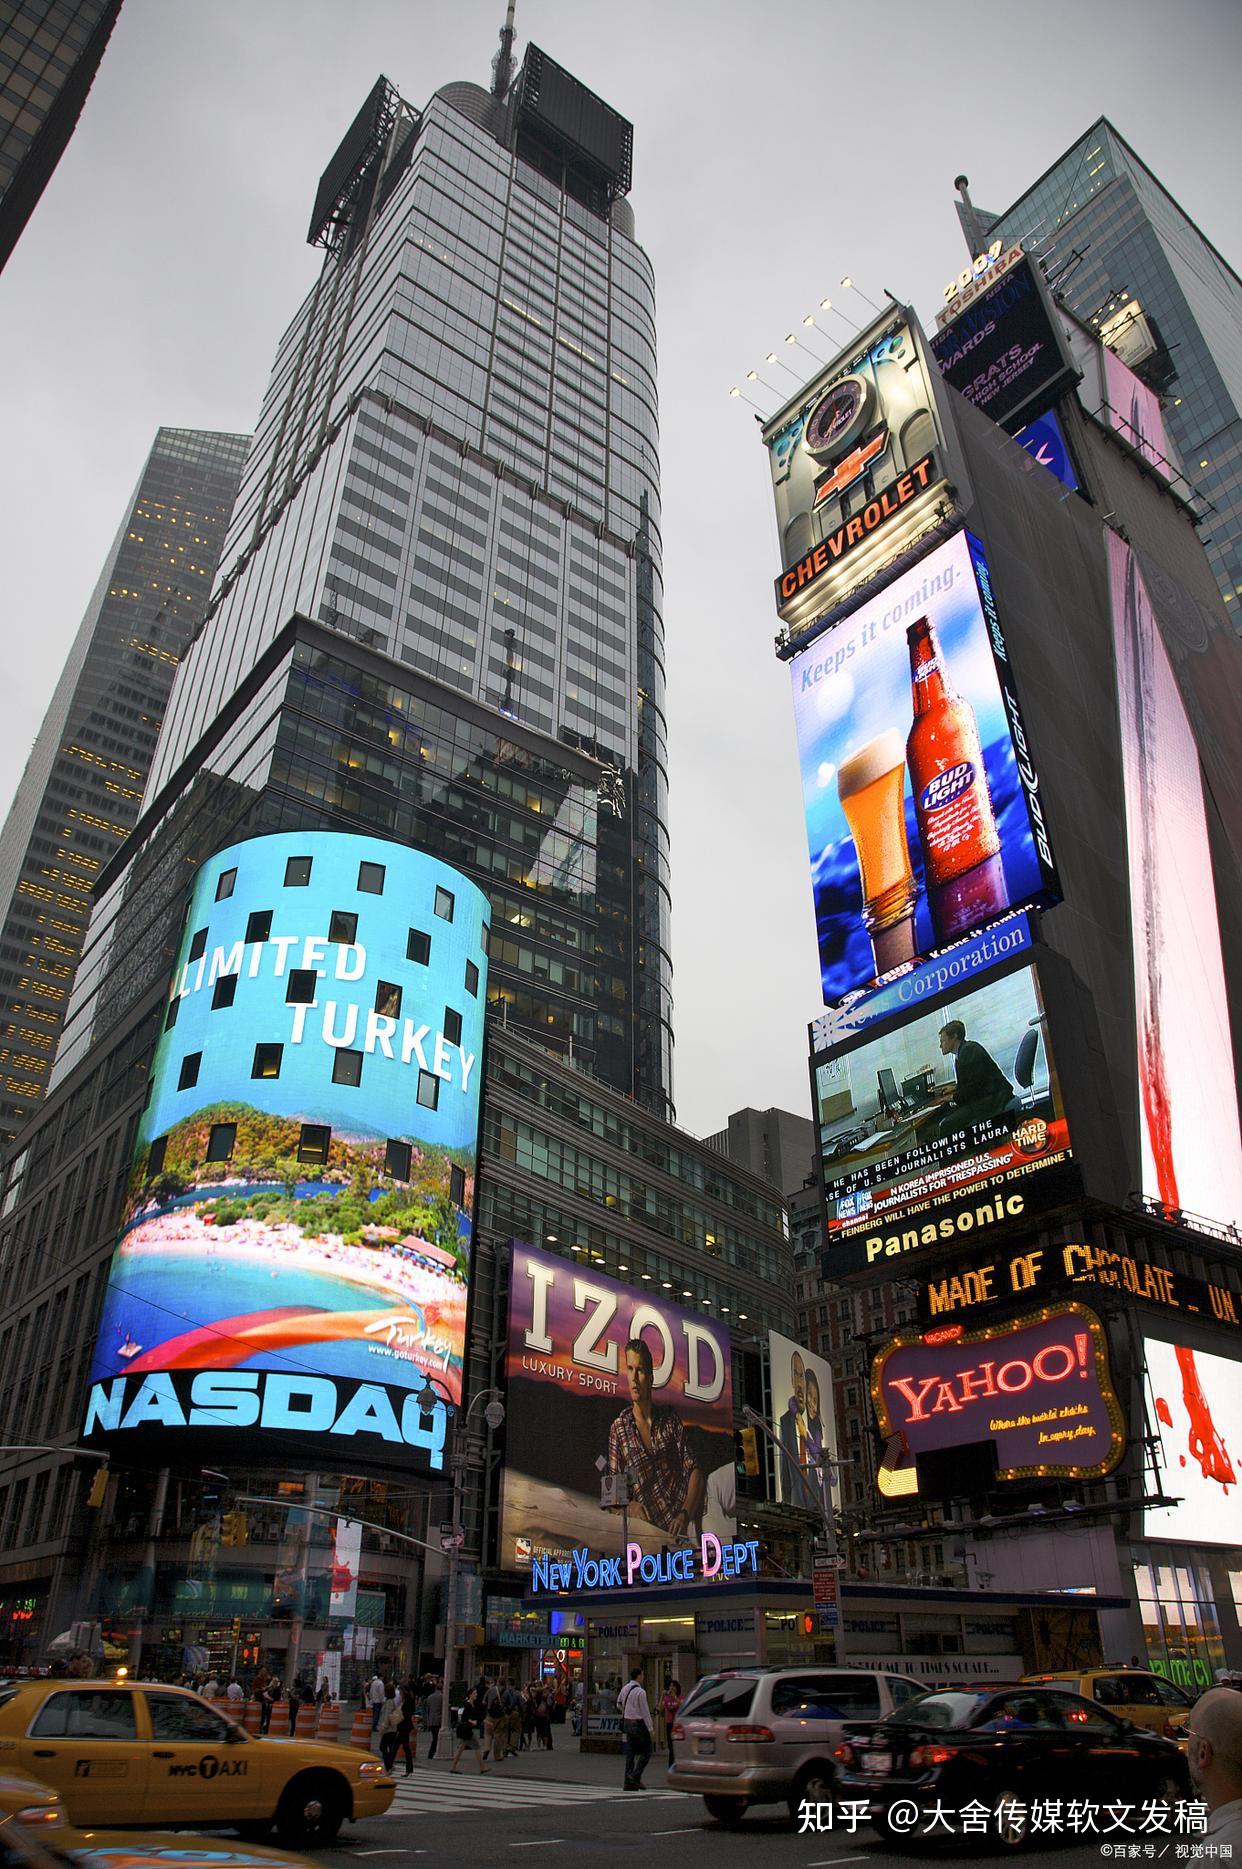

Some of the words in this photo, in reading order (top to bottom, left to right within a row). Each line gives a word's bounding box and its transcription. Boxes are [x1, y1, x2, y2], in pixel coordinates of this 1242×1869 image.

[938, 249, 1022, 324] TOSHIBA
[970, 379, 1000, 402] HIGH
[780, 458, 934, 599] CHEVROLET
[801, 640, 856, 692] Keeps
[862, 623, 877, 646] it
[883, 562, 961, 631] coming.
[990, 618, 1007, 662] Keeps
[1004, 686, 1036, 777] LIGHT
[924, 770, 974, 810] LIGHT
[929, 763, 968, 795] BUD
[1026, 794, 1054, 869] BUD
[898, 927, 1025, 1003] Corporation
[286, 1000, 475, 1094] TURKEY
[1011, 1121, 1047, 1140] HARD
[1015, 1132, 1047, 1149] TIME
[833, 1177, 845, 1189] HE
[851, 1168, 869, 1183] HAS
[875, 1157, 900, 1172] BEEN
[972, 1119, 992, 1134] THE
[846, 1183, 858, 1194] OF
[864, 1173, 886, 1187] U.S.
[894, 1142, 967, 1176] JOURNALISTS
[974, 1125, 1009, 1146] LAURA
[890, 1186, 899, 1196] N
[898, 1176, 925, 1194] KOREA
[924, 1158, 975, 1184] IMPRISONED
[975, 1152, 992, 1165] U.S.
[841, 1218, 883, 1239] FEINBERG
[884, 1210, 906, 1224] WILL
[907, 1202, 931, 1216] HAVE
[931, 1195, 951, 1207] THE
[953, 1180, 989, 1200] POWER
[990, 1173, 1004, 1186] TO
[1006, 1153, 1066, 1181] DETERMINE
[841, 1196, 855, 1210] FOX
[873, 1187, 929, 1214] JOURNALISTS
[929, 1178, 947, 1192] FOR
[866, 1192, 1025, 1263] Panasonic
[928, 1265, 998, 1316] MADE
[1009, 1250, 1044, 1292] OF
[364, 1316, 453, 1373] Turkey
[524, 1259, 726, 1403] IZOD
[924, 1325, 962, 1344] VACANCY
[368, 1344, 443, 1370] www.goturkey.com
[522, 1355, 574, 1382] LUXURY
[579, 1373, 618, 1395] SPORT
[888, 1333, 1089, 1423] YAHOO!
[83, 1371, 447, 1470] NASDAQ
[990, 1419, 1016, 1431] Where
[1016, 1415, 1031, 1427] the
[1032, 1408, 1058, 1424] world
[572, 1548, 623, 1590] YORK
[627, 1543, 694, 1585] POLICE
[701, 1533, 759, 1578] DEPT
[599, 1626, 629, 1638] POLICE
[706, 1618, 744, 1633] POLICE
[852, 1620, 887, 1634] POLICE
[920, 1662, 950, 1674] TIMES
[168, 1765, 197, 1777] NYC
[199, 1755, 248, 1780] TAXI
